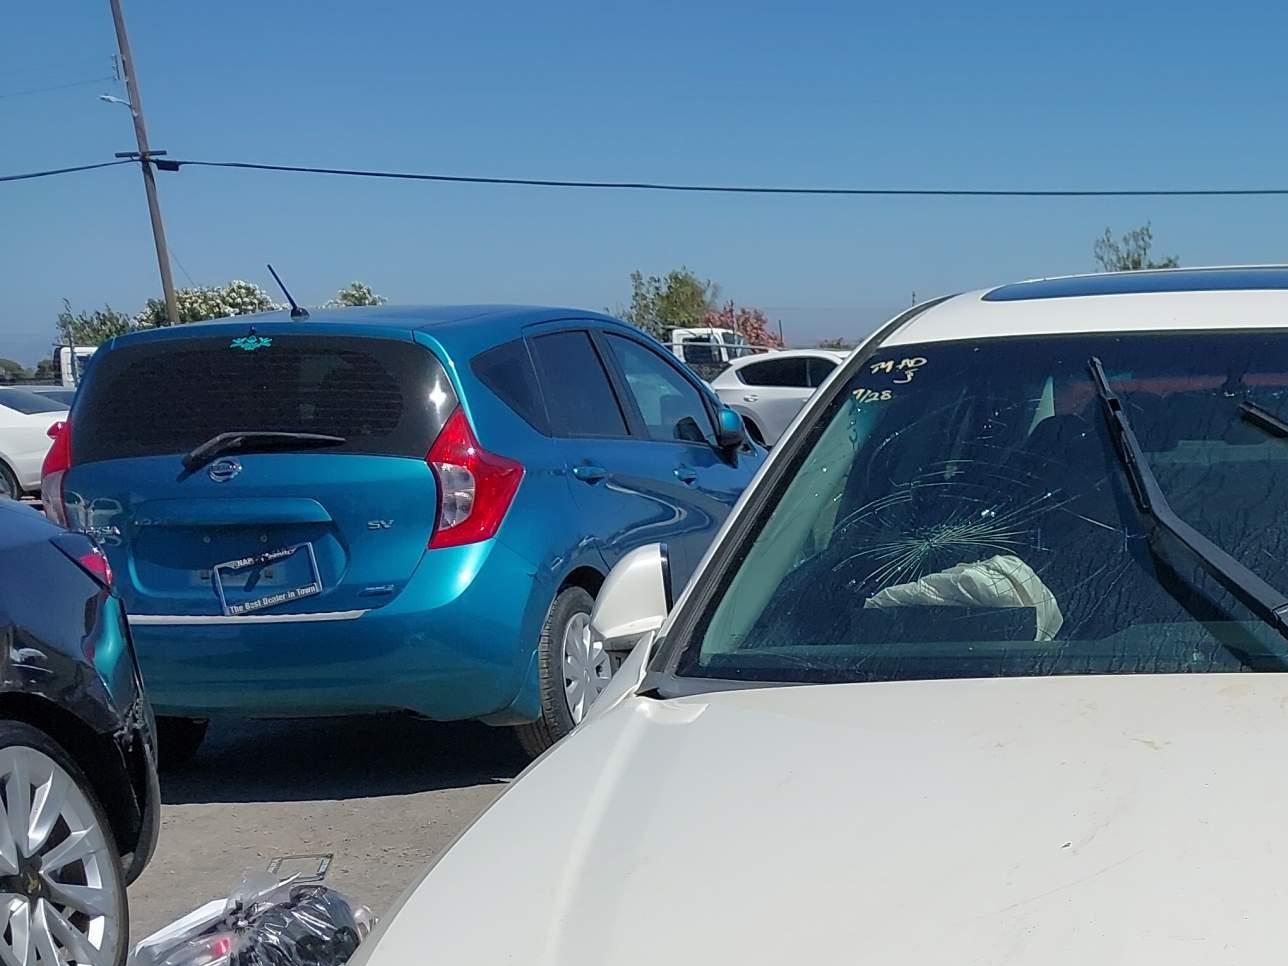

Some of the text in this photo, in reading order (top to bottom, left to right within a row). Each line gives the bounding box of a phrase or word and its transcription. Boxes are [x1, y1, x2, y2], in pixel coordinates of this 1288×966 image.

[367, 519, 394, 529] SV
[229, 604, 244, 614] The
[245, 600, 261, 610] Best
[263, 593, 286, 605] Dealer
[296, 584, 317, 596] Town
